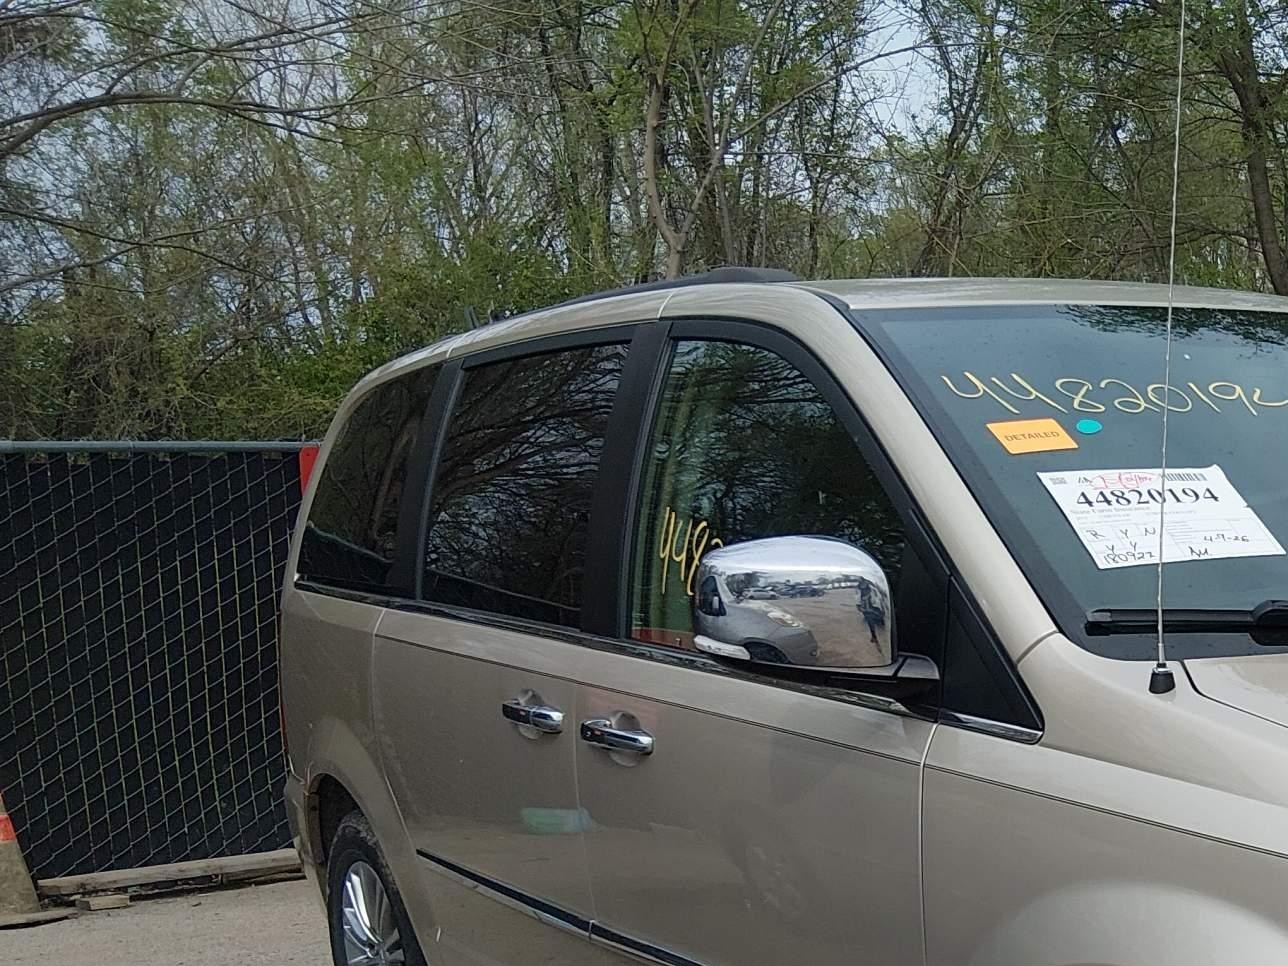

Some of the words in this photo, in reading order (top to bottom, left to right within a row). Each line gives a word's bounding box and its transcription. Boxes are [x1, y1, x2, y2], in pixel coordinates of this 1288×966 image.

[1004, 431, 1061, 443] DETAILED
[1076, 486, 1220, 507] 44820194
[659, 506, 724, 596] 448
